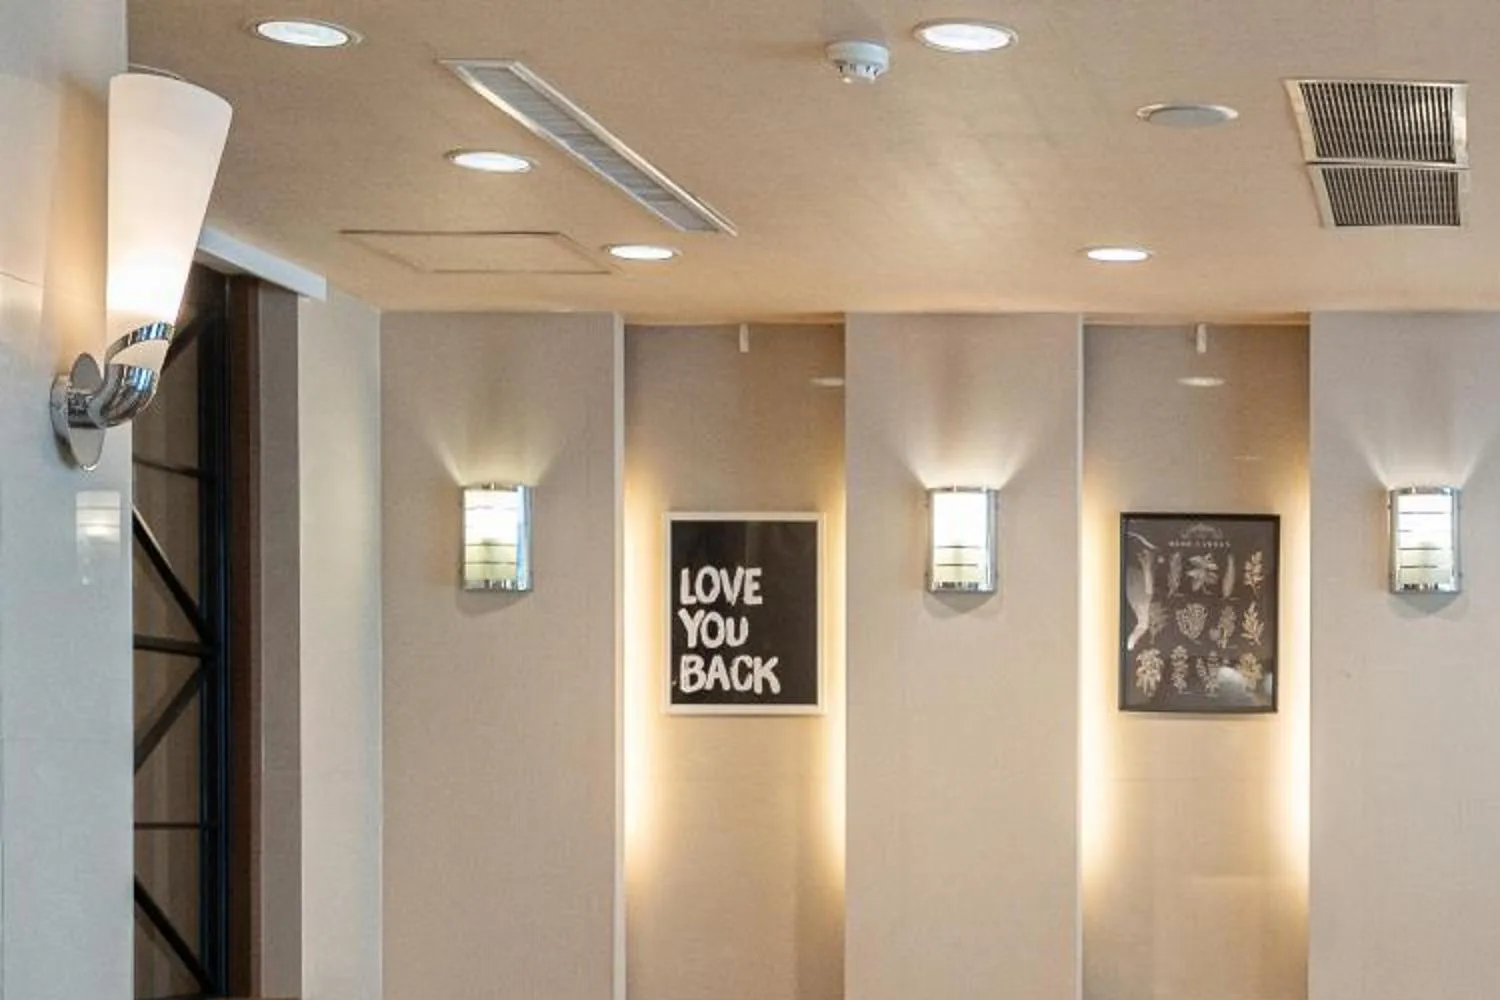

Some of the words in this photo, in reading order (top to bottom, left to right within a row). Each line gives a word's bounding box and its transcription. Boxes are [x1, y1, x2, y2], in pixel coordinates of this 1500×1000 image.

[680, 565, 763, 606] LOVE
[678, 608, 749, 648] YOU
[680, 654, 781, 694] BACK
